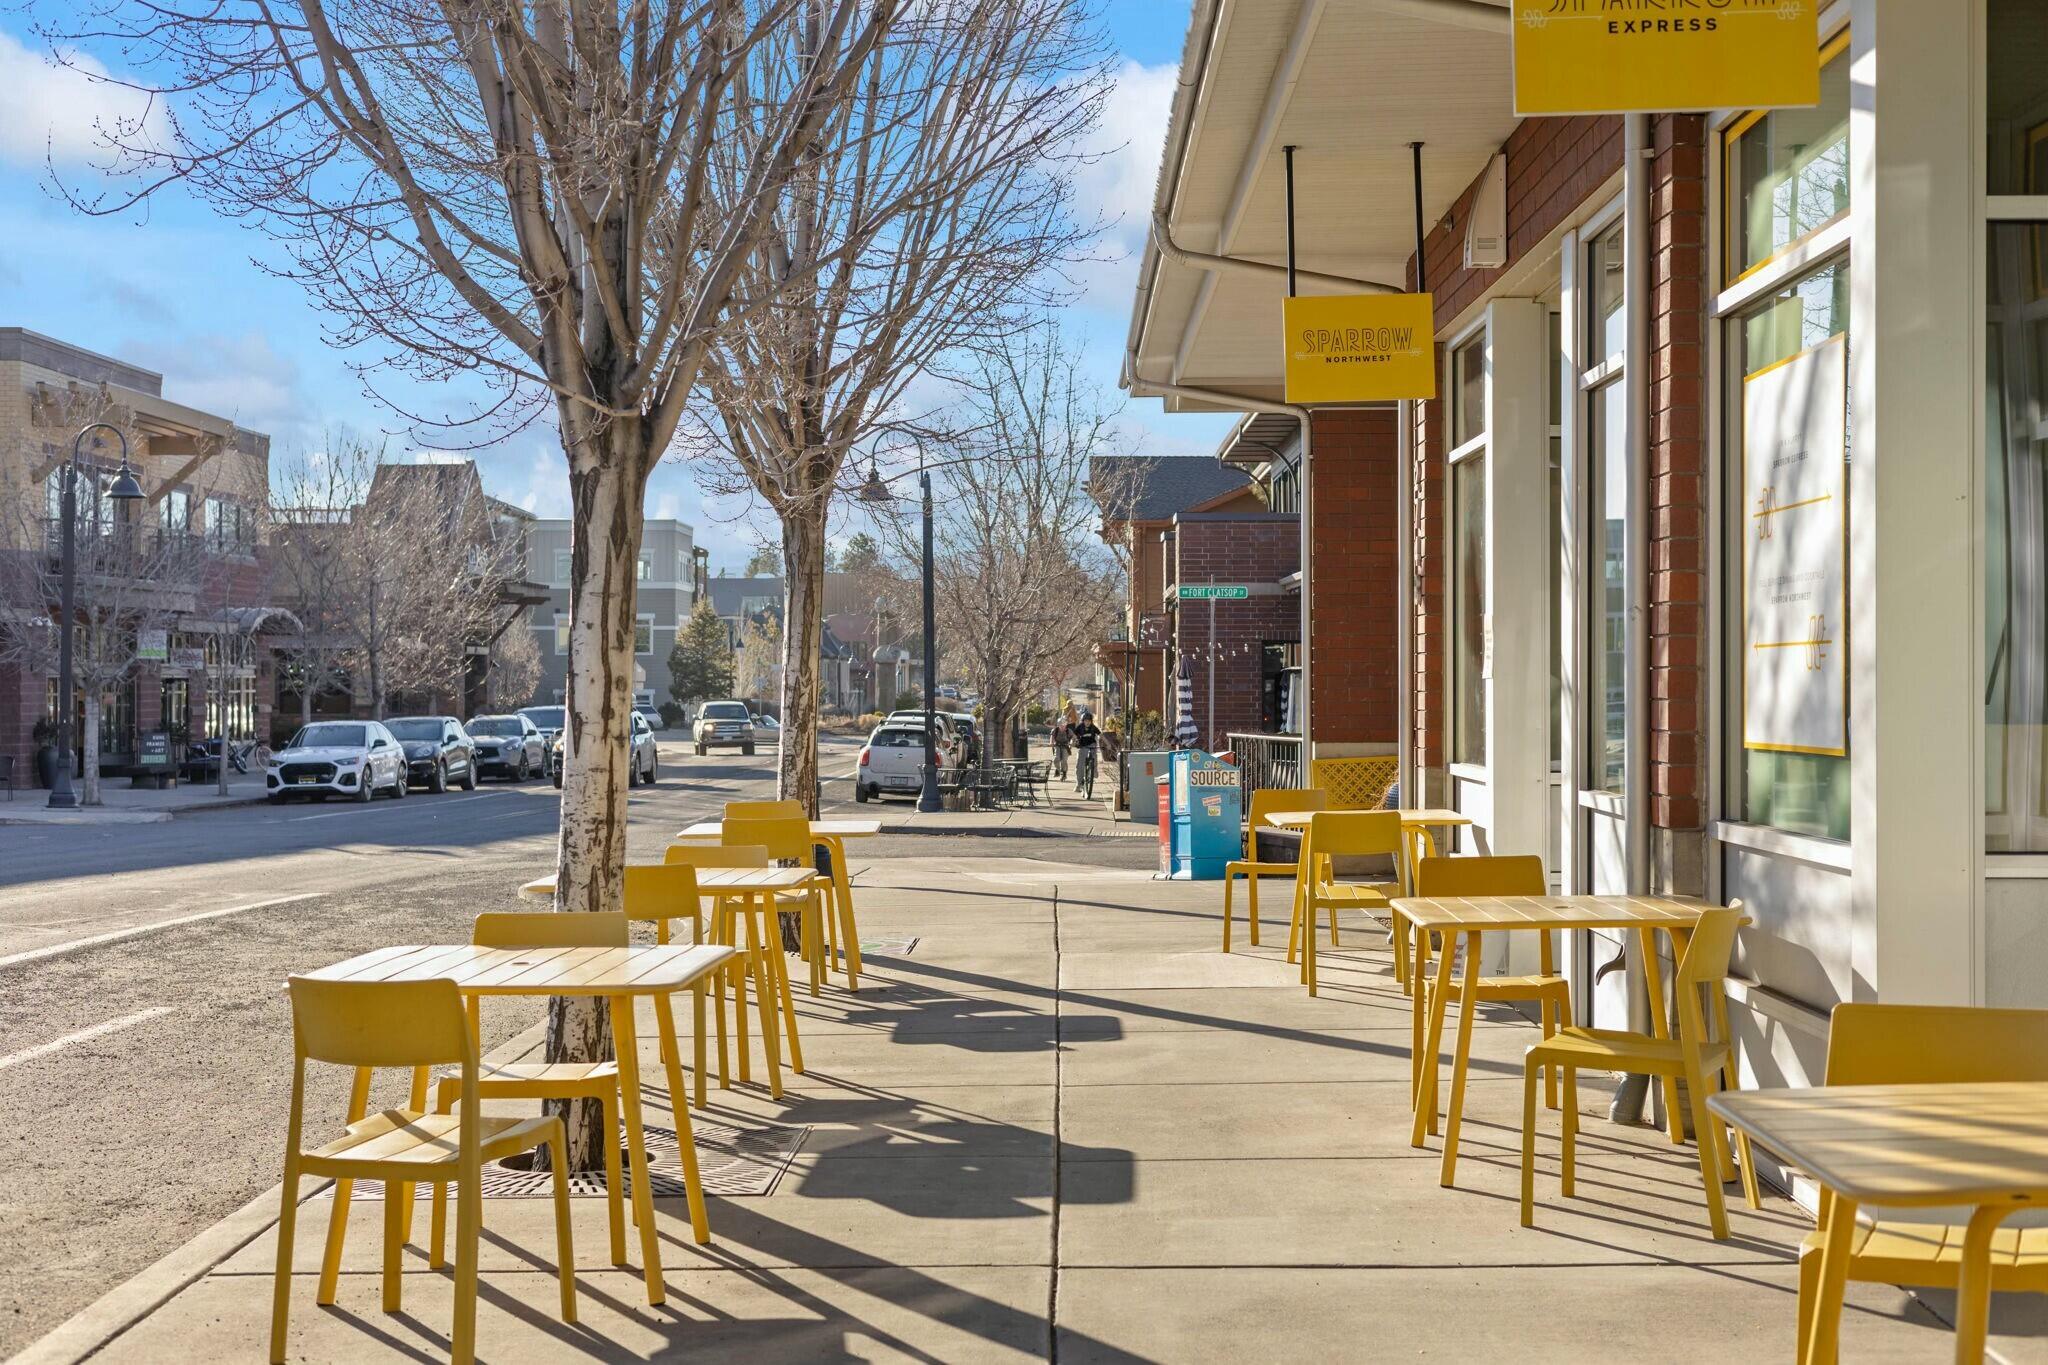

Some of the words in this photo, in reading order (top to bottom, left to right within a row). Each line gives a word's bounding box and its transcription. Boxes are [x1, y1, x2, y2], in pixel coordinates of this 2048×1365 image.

[1608, 18, 1717, 34] EXPRESS
[1302, 328, 1413, 352] SPARROW
[1325, 355, 1391, 363] NORTHWEST
[1188, 588, 1206, 597] FORT
[1207, 588, 1237, 597] CLATSOP
[1191, 771, 1236, 786] SOURCE
